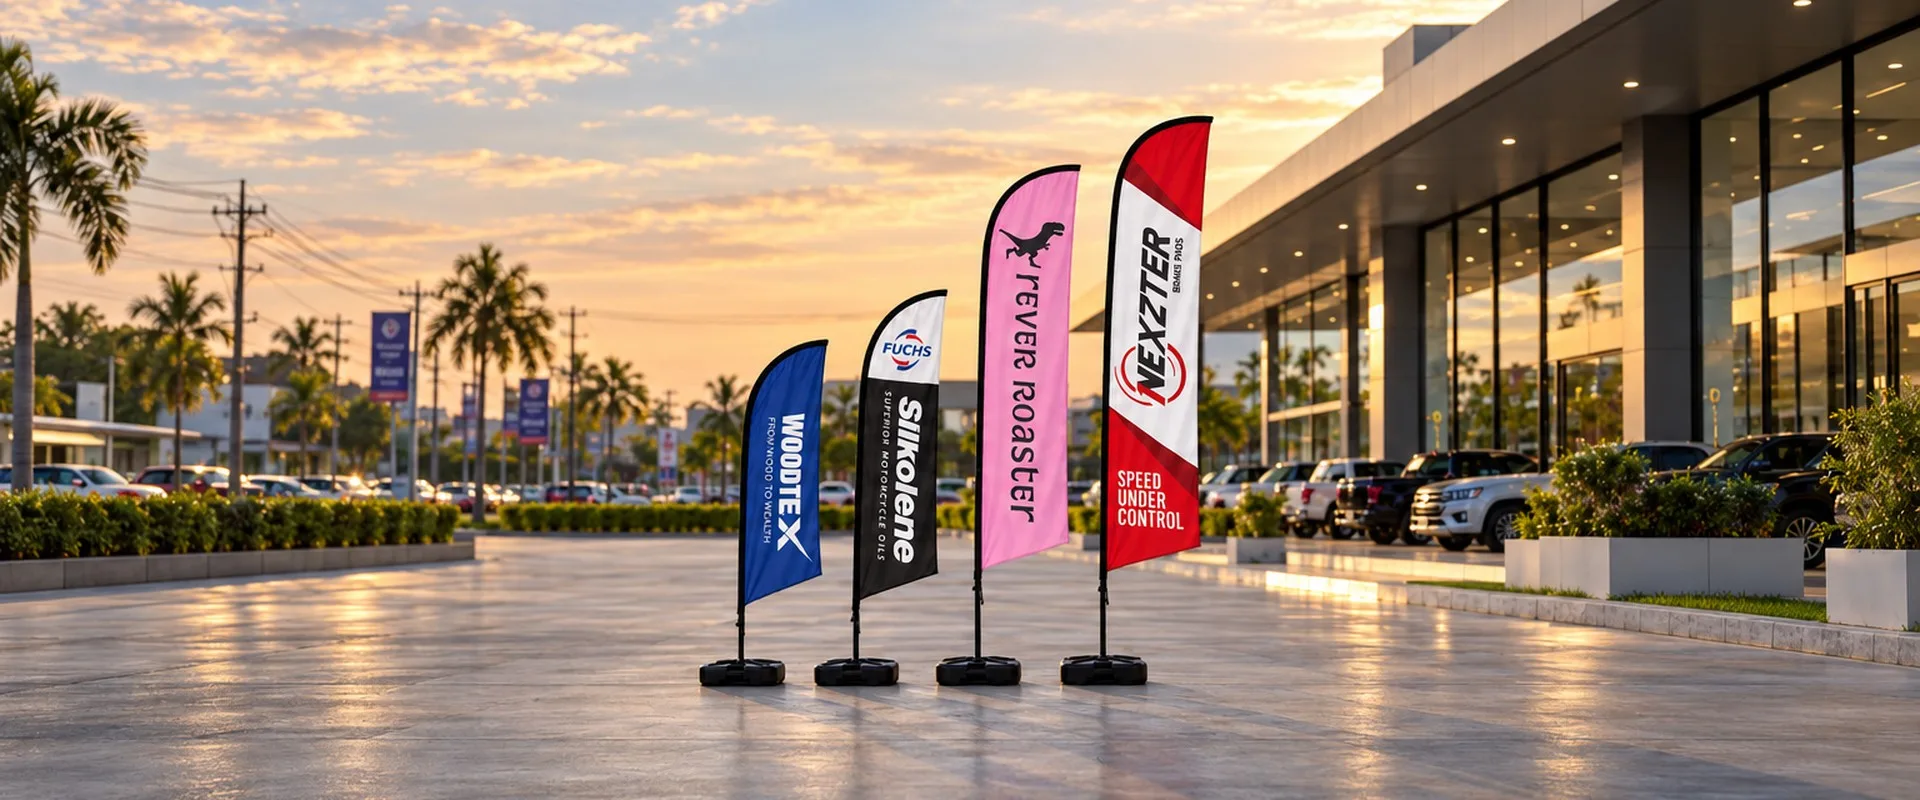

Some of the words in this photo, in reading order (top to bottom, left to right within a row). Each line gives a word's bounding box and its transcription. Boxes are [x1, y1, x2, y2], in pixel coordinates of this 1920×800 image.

[1136, 227, 1170, 406] NEXZTER
[882, 342, 932, 357] FUCHS
[882, 390, 892, 445] SUPERIOR
[764, 484, 773, 500] TO
[777, 413, 813, 563] WOODTEX
[878, 450, 889, 529] MOTORCYCLE
[893, 396, 923, 564] Silkolene
[1117, 470, 1161, 489] SPEED
[1117, 488, 1166, 509] UNDER
[1117, 508, 1185, 530] CONTROL
[877, 534, 886, 561] OILS
